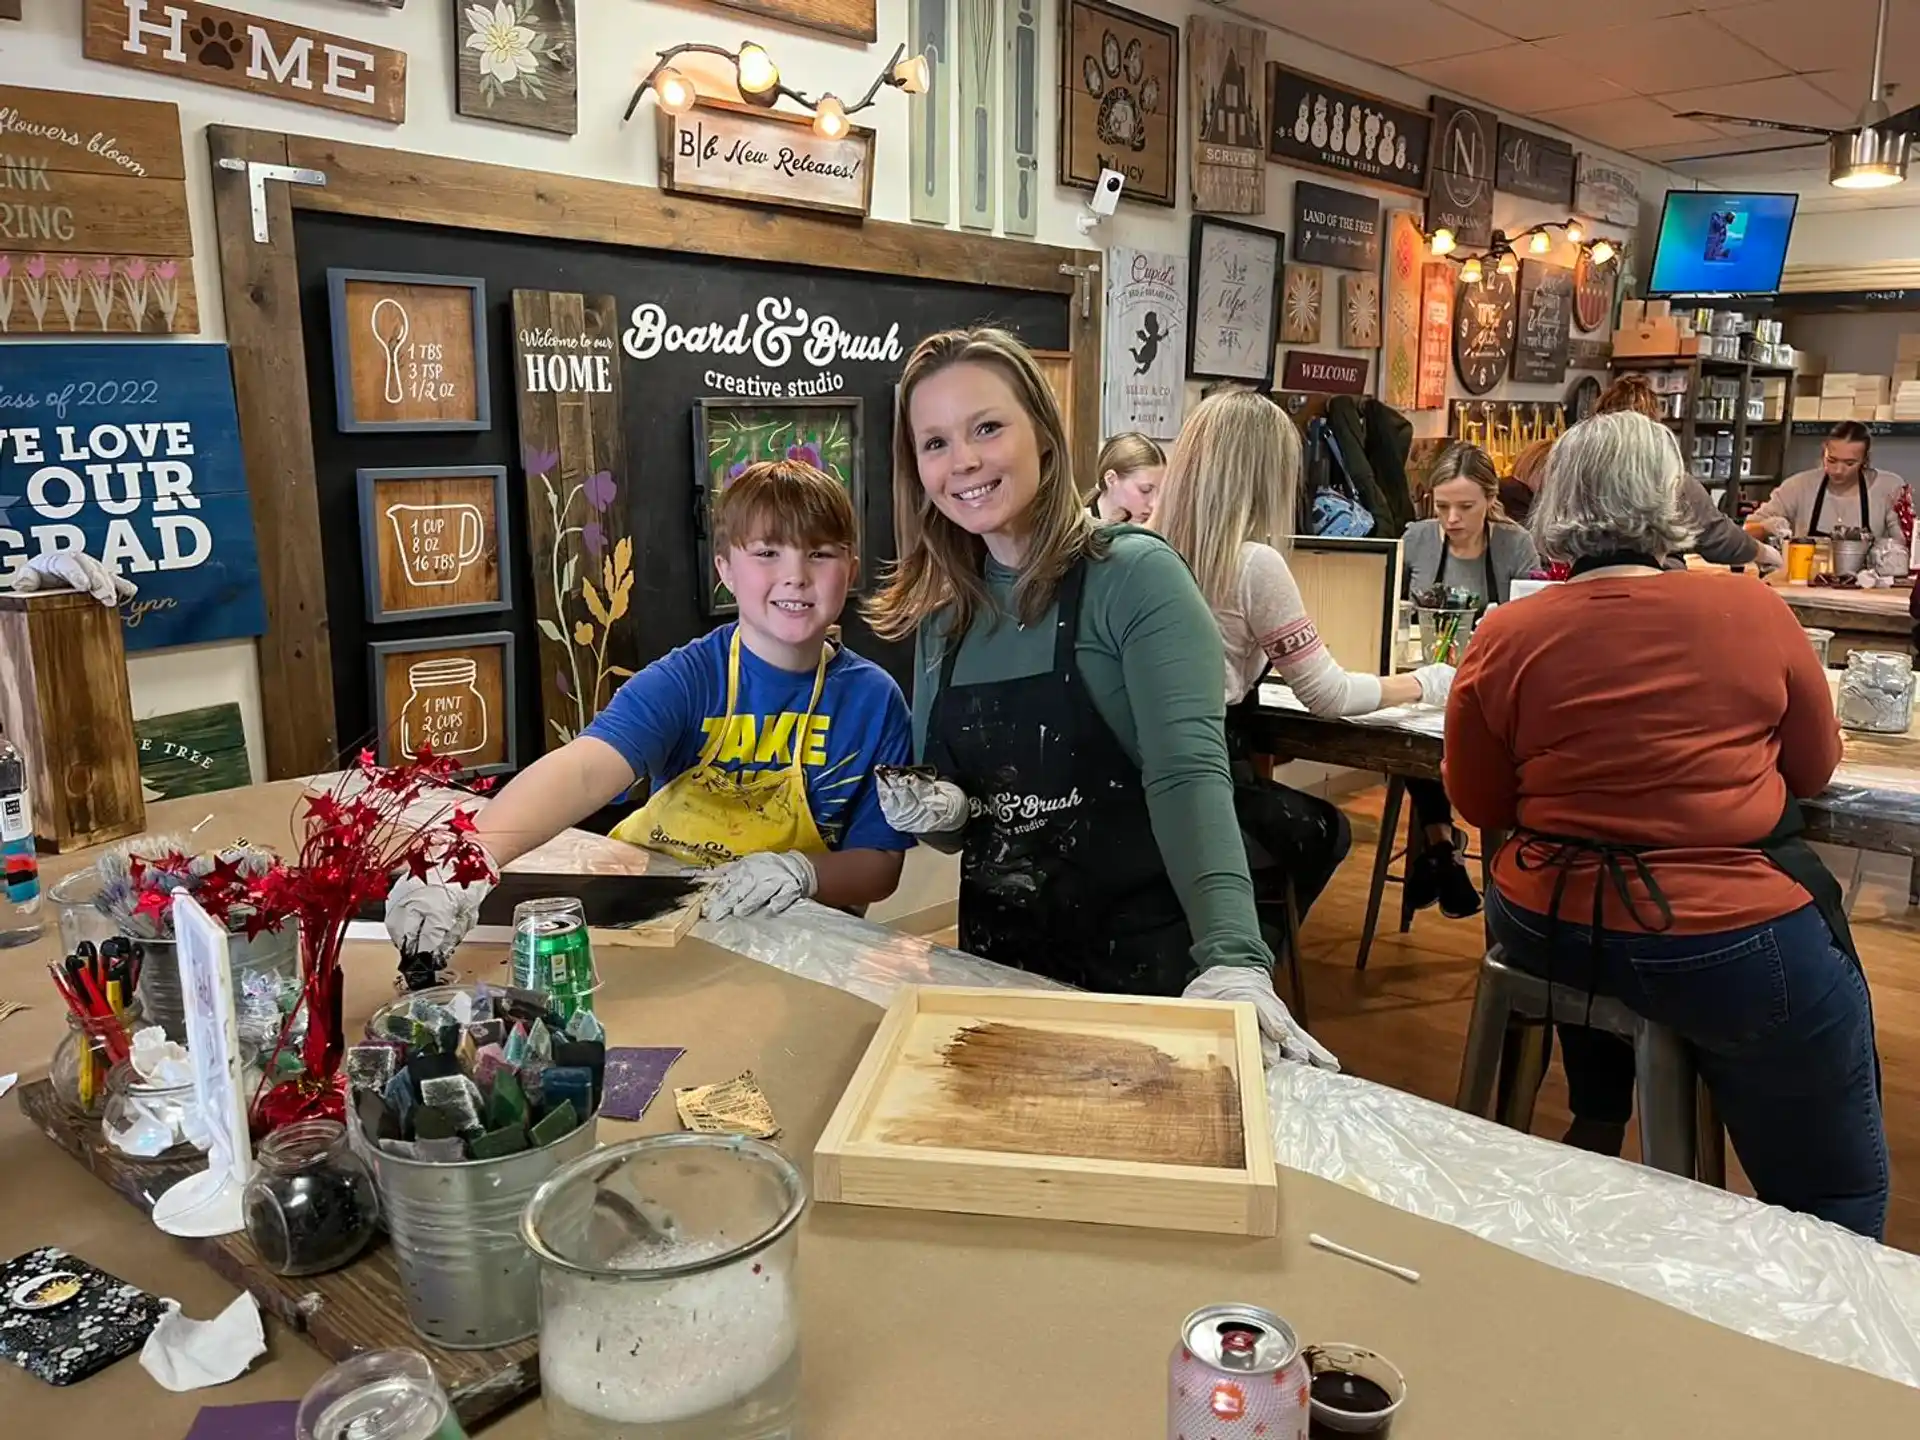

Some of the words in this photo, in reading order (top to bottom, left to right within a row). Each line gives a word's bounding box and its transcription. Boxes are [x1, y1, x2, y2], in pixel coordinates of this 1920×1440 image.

[122, 0, 375, 104] HME
[87, 132, 149, 177] bloom
[724, 140, 769, 166] New
[774, 147, 861, 178] Releases!
[0, 153, 52, 191] NK
[1302, 209, 1326, 225] LAND
[1326, 213, 1338, 228] OF
[1338, 216, 1354, 231] THE
[1354, 219, 1375, 236] FREE
[519, 327, 579, 349] Welcome
[580, 332, 592, 348] to
[593, 337, 615, 350] our
[623, 303, 751, 360] Board
[752, 297, 808, 368] &
[803, 315, 903, 367] Brush
[408, 343, 415, 360] 1
[419, 343, 443, 360] TBS
[408, 362, 418, 380] 3
[422, 363, 443, 380] TSP
[523, 353, 613, 392] HOME
[704, 369, 782, 397] creative
[788, 372, 844, 397] studio
[1302, 363, 1358, 383] WELCOME
[46, 383, 76, 419] of
[77, 380, 159, 406] 2022
[409, 380, 438, 402] 1/2
[440, 382, 456, 398] OZ
[56, 422, 194, 462] LOVE
[27, 461, 201, 519] OUR
[410, 519, 418, 536] 1
[423, 519, 445, 535] CUP
[412, 537, 420, 553] 8
[424, 536, 440, 552] OZ
[411, 554, 430, 571] 16
[433, 553, 455, 569] TBS
[422, 698, 430, 713] 1
[434, 696, 464, 712] PINT
[422, 715, 434, 733] 2
[437, 712, 463, 730] CUPS
[443, 731, 459, 746] OZ
[698, 711, 831, 766] TAKE
[163, 741, 214, 770] TREE
[1020, 786, 1083, 819] Brush
[1013, 819, 1046, 835] studio
